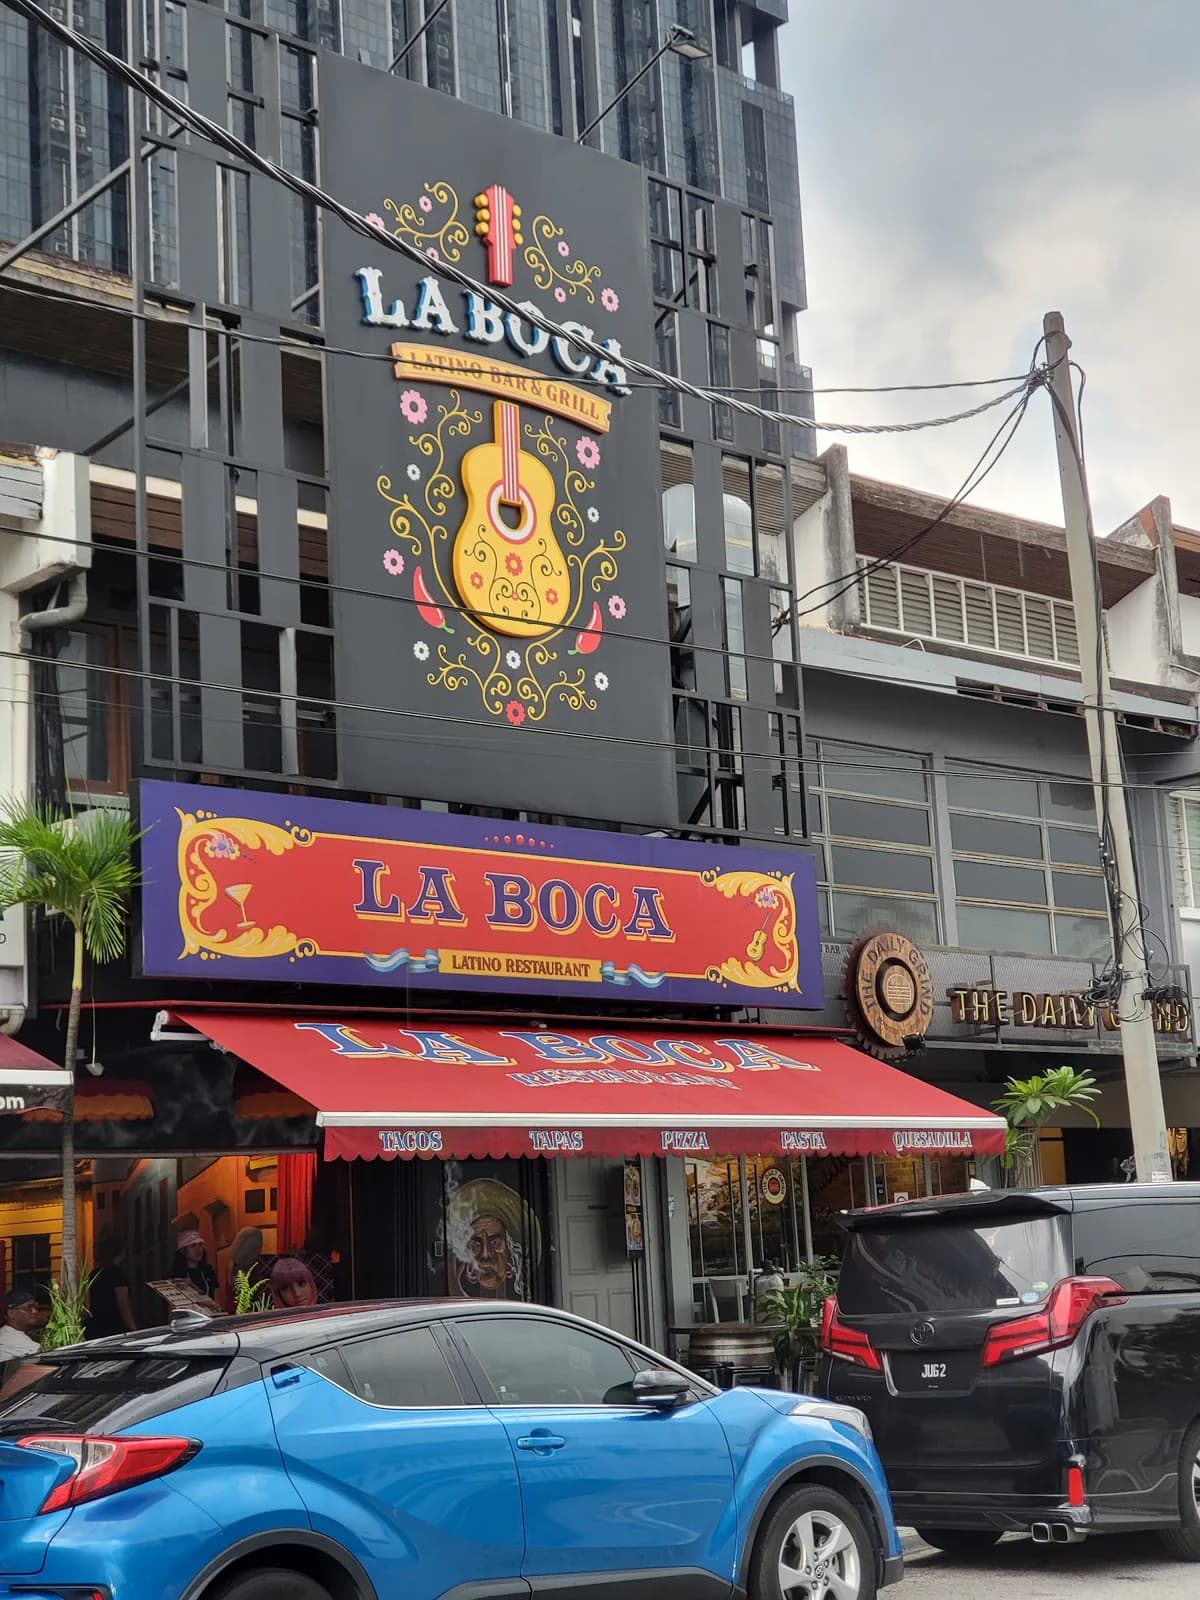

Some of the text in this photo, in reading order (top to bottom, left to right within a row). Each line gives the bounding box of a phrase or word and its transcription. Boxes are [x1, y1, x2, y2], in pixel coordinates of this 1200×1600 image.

[354, 266, 632, 396] LA BOCA
[410, 351, 482, 379] LATINO
[352, 858, 676, 944] LA BOCA
[451, 954, 591, 977] LATINO RESTAURANT
[949, 987, 1009, 1024] THE
[1014, 991, 1096, 1028] DAILY
[294, 1022, 822, 1073] LA BOCA
[506, 1068, 742, 1091] RESTAURANT
[378, 1129, 443, 1152] TACOS
[528, 1130, 583, 1151] TAPAS
[660, 1130, 709, 1150] PIZZA
[780, 1130, 827, 1150] PASTA
[892, 1130, 972, 1151] QUESADILLA
